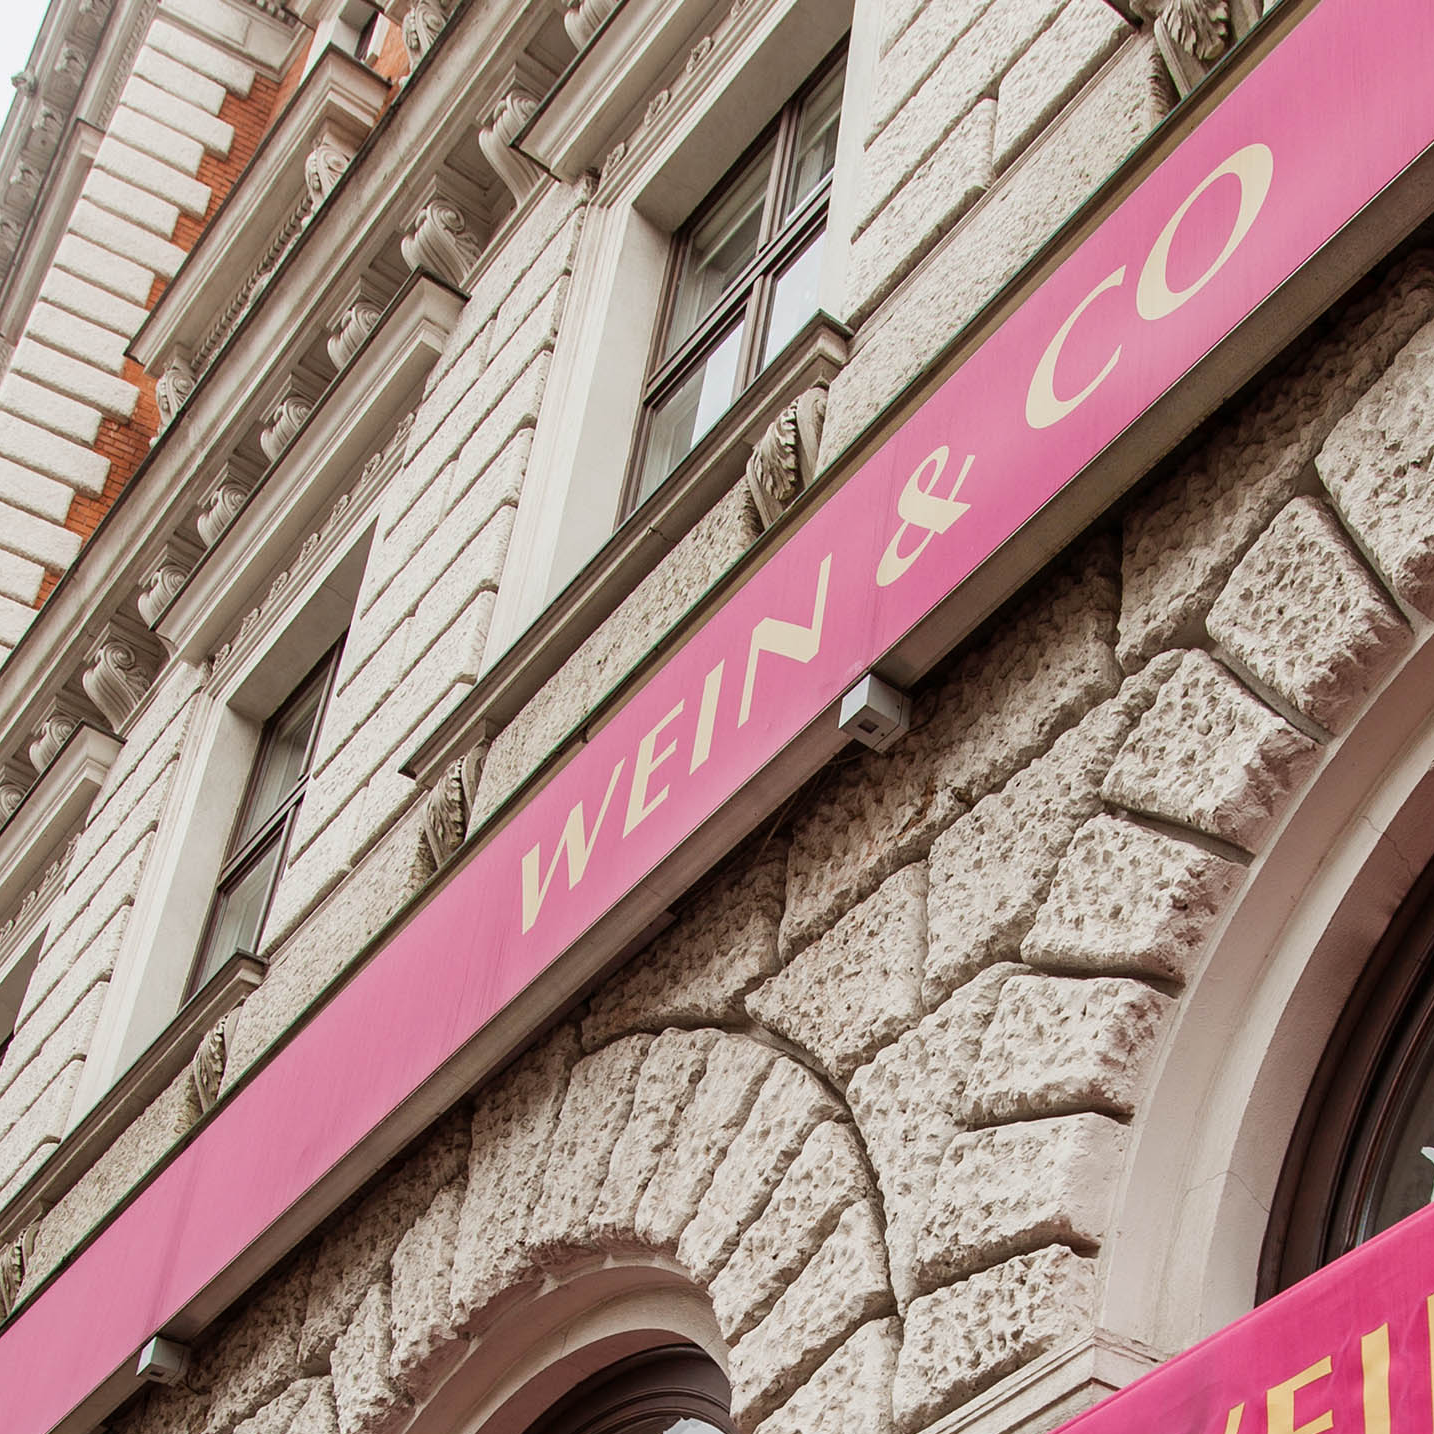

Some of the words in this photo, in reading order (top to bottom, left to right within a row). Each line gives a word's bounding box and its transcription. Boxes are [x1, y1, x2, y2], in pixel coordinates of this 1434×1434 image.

[521, 553, 833, 934] WEIN
[875, 445, 976, 588] &
[1025, 142, 1275, 430] CO
